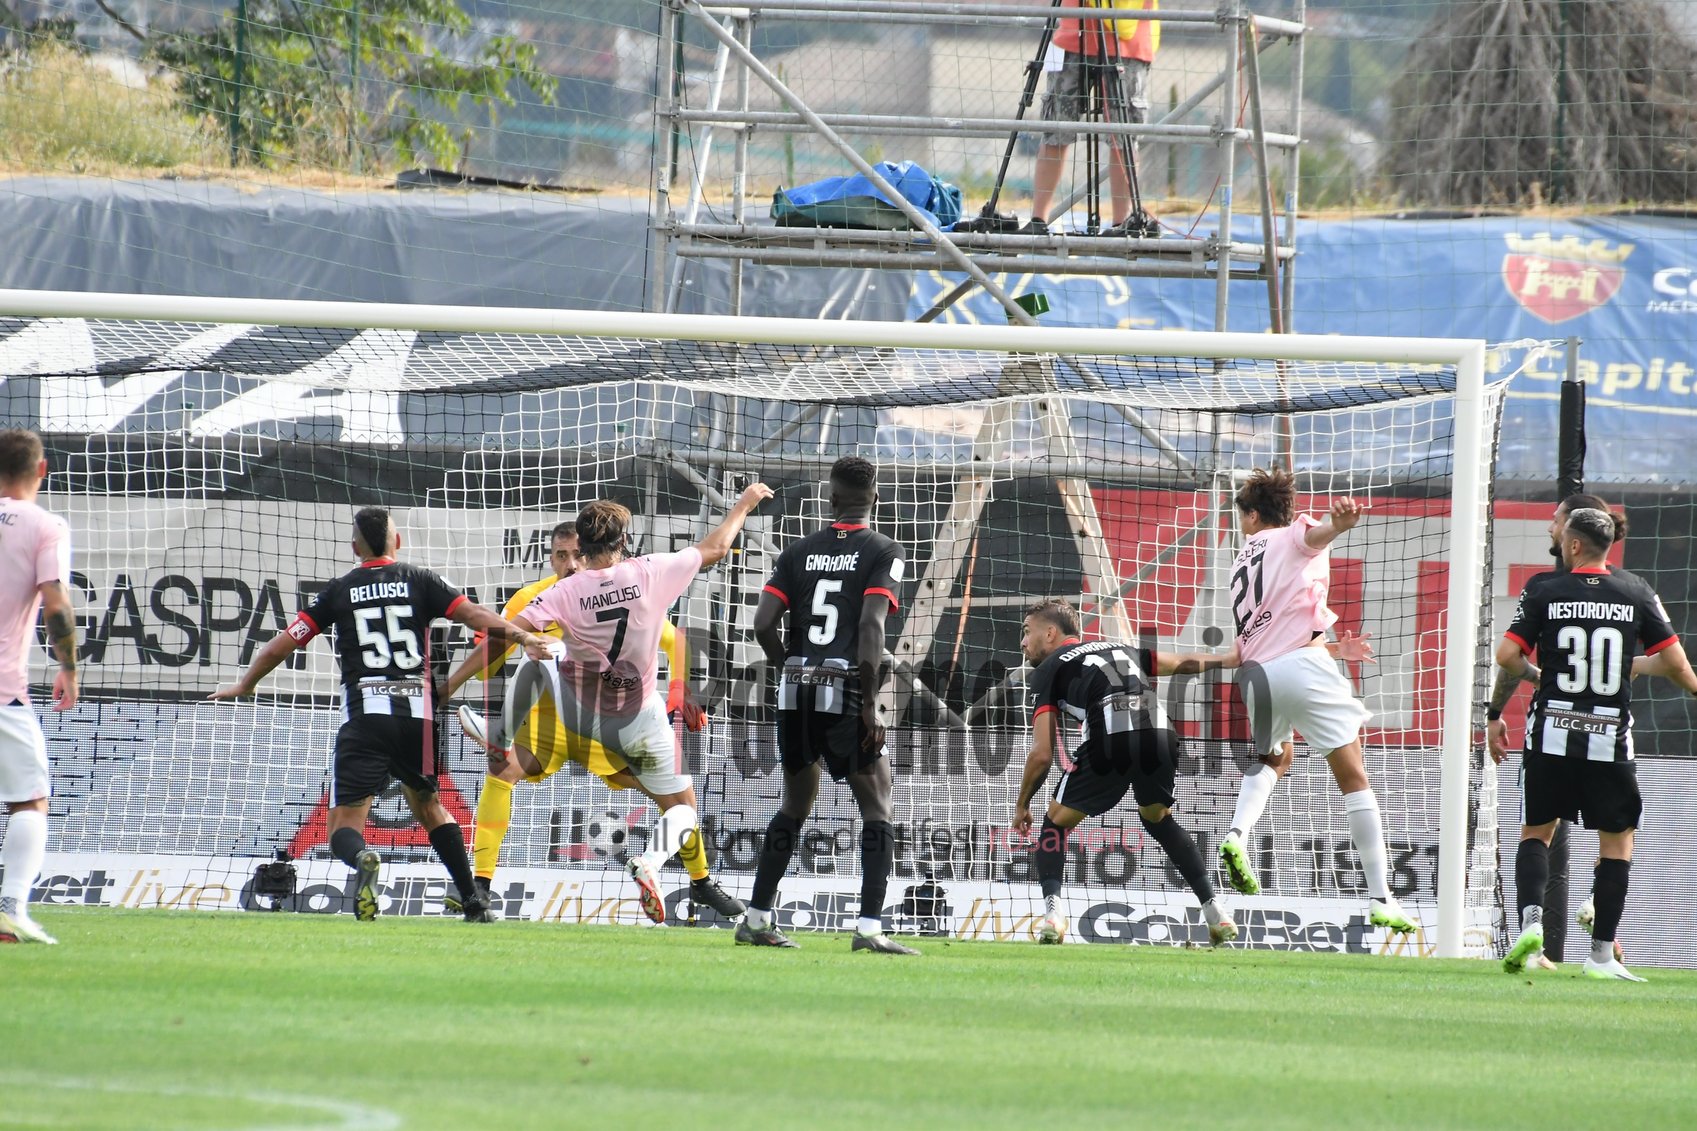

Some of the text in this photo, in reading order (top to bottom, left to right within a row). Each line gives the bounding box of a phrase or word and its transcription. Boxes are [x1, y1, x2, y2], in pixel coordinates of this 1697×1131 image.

[1653, 266, 1697, 296] C
[1523, 348, 1697, 395] Capit
[350, 582, 409, 604] BELLUSCI
[579, 584, 642, 611] MANCUSO
[808, 578, 842, 646] 5
[1230, 550, 1265, 638] 27
[1548, 601, 1634, 623] NESTOROVSKI
[353, 605, 422, 670] 55
[595, 606, 630, 667] 7
[1556, 625, 1622, 697] 30
[1554, 717, 1605, 734] I.G.C. s.r.l.
